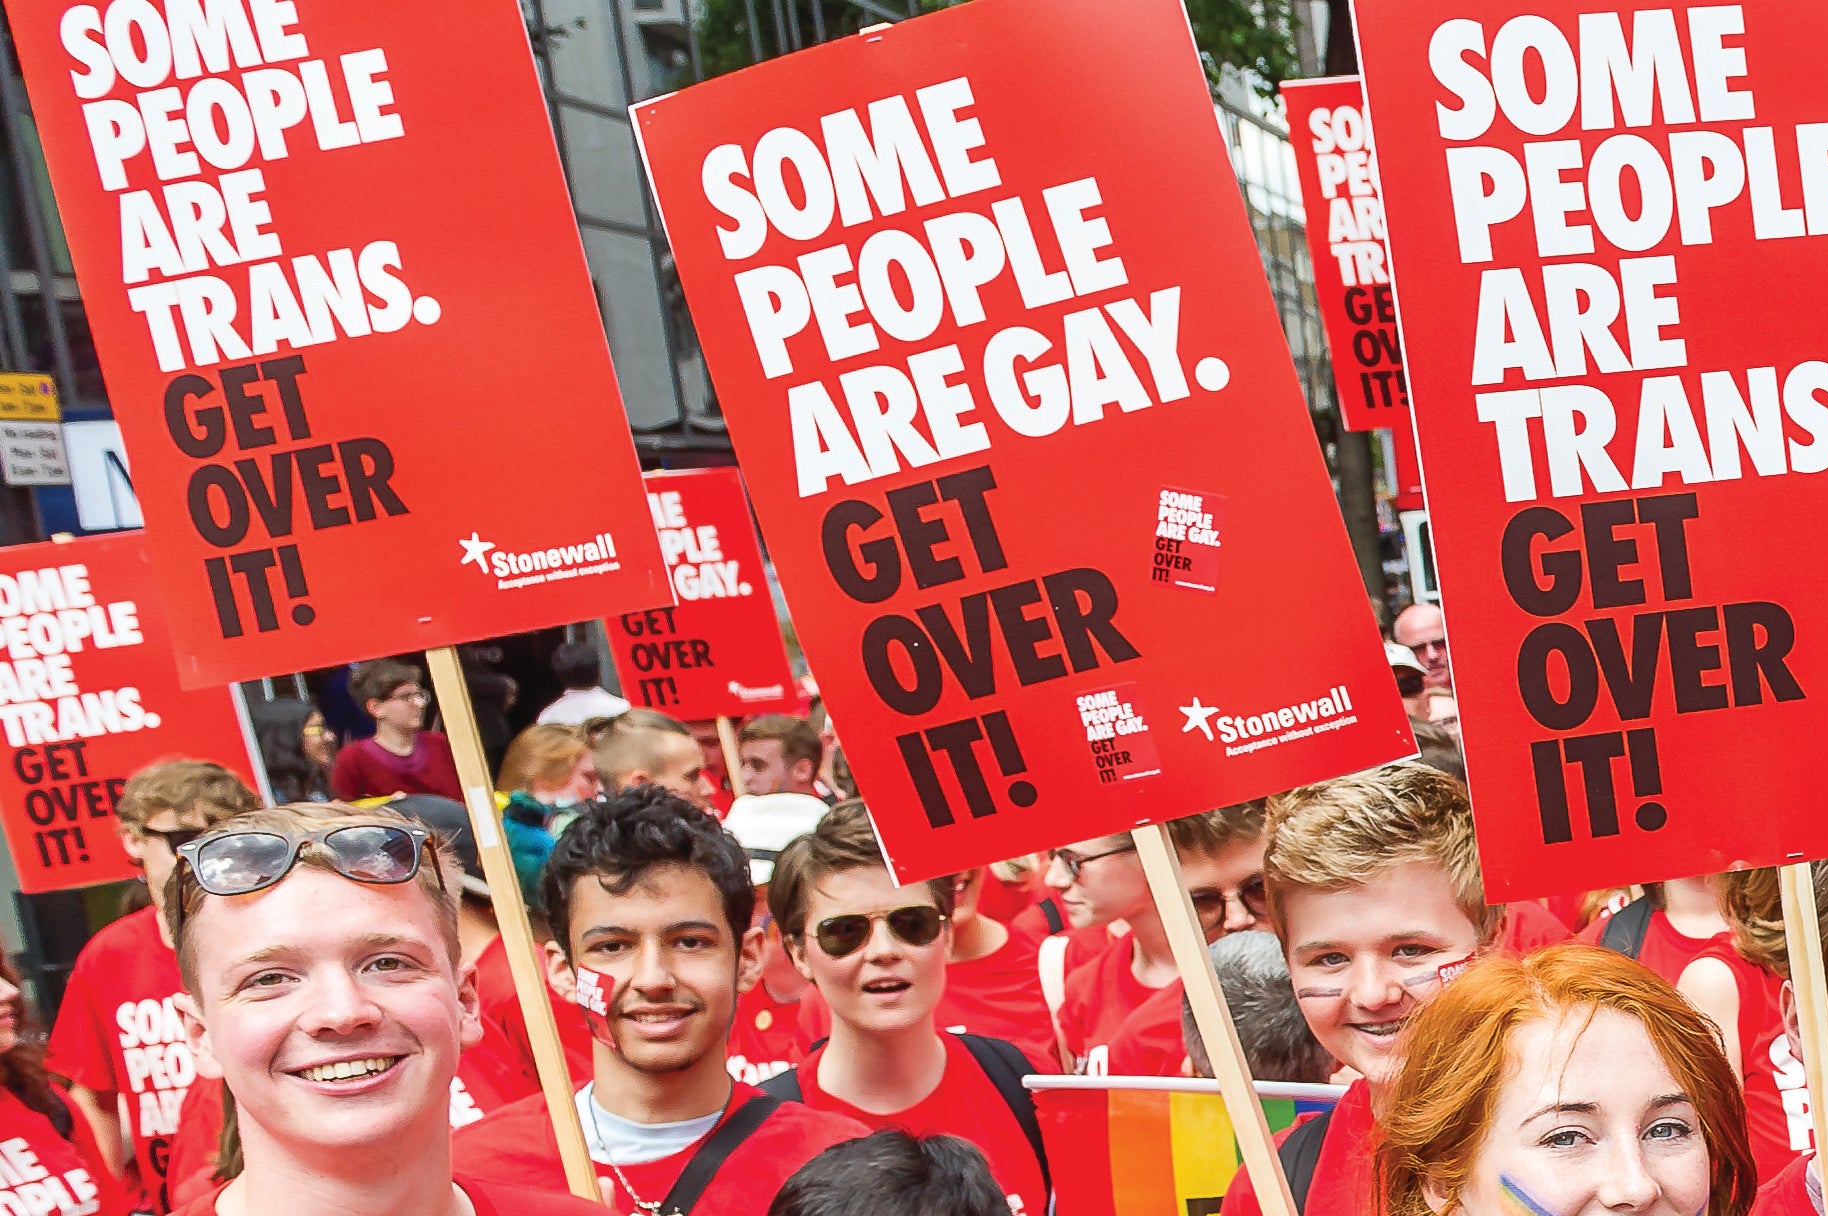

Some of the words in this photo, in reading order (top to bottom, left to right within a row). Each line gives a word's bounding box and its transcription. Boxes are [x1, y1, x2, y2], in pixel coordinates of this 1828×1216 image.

[59, 0, 309, 99] SOME
[1428, 4, 1757, 141] SOME
[82, 48, 405, 190] PEOPLE
[702, 76, 1002, 262] SOME
[119, 168, 282, 283] ARE
[130, 240, 441, 372] TRANS.
[734, 176, 1129, 380] PEOPLE
[1470, 255, 1688, 387] ARE
[164, 354, 311, 458] GET
[786, 350, 991, 498] ARE
[983, 285, 1231, 438] GAY.
[187, 436, 410, 547] OVER
[1158, 505, 1213, 530] PEOPLE
[1159, 490, 1203, 512] SOME
[491, 533, 616, 577] Stonewall
[821, 464, 1008, 605] GET
[1154, 553, 1192, 571] OVER
[1155, 521, 1187, 540] ARE
[1188, 526, 1221, 547] GAY.
[1155, 537, 1182, 553] GET
[1500, 492, 1699, 617] GET
[205, 542, 316, 639] IT!
[673, 560, 752, 601] GAY.
[620, 606, 676, 637] GET
[862, 566, 1143, 718] OVER
[631, 640, 715, 672] OVER
[1517, 600, 1806, 733] OVER
[0, 687, 161, 747] TRANS.
[639, 677, 679, 707] IT!
[1077, 690, 1119, 712] SOME
[1080, 703, 1134, 727] PEOPLE
[1216, 685, 1353, 743] Stonewall
[1087, 722, 1115, 741] ARE
[1115, 716, 1149, 735] GAY.
[1091, 737, 1115, 754] GET
[14, 741, 88, 784] GET
[895, 709, 1038, 830] IT!
[1096, 751, 1133, 768] OVER
[1531, 728, 1669, 846] IT!
[35, 826, 90, 867] IT!
